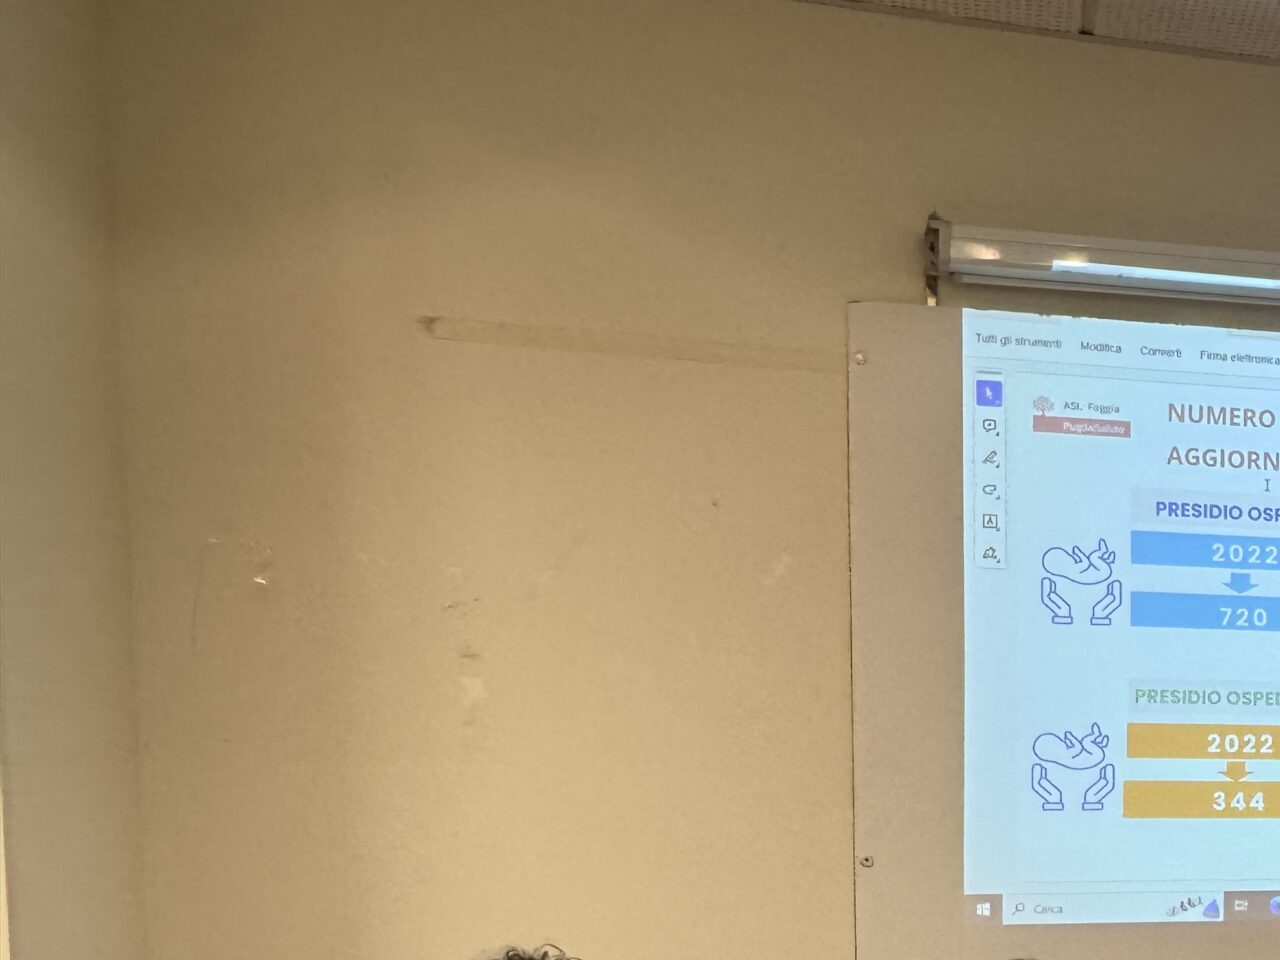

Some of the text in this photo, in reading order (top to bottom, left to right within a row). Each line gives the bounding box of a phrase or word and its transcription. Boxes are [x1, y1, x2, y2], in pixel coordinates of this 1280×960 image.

[975, 332, 1063, 350] Tutti gli strumenti
[1080, 341, 1122, 354] Modifica
[1140, 345, 1182, 358] Converti
[1200, 350, 1280, 366] Firma elettronica
[1063, 401, 1120, 415] ASL Foggia
[1167, 402, 1276, 428] NUMERO
[1155, 500, 1244, 521] PRESIDIO
[1211, 542, 1279, 565] 2022
[1219, 607, 1268, 628] 720
[1134, 687, 1222, 706] PRESIDIO
[1207, 733, 1274, 754] 2022
[1211, 791, 1266, 812] 344
[1033, 904, 1064, 915] Cerca
